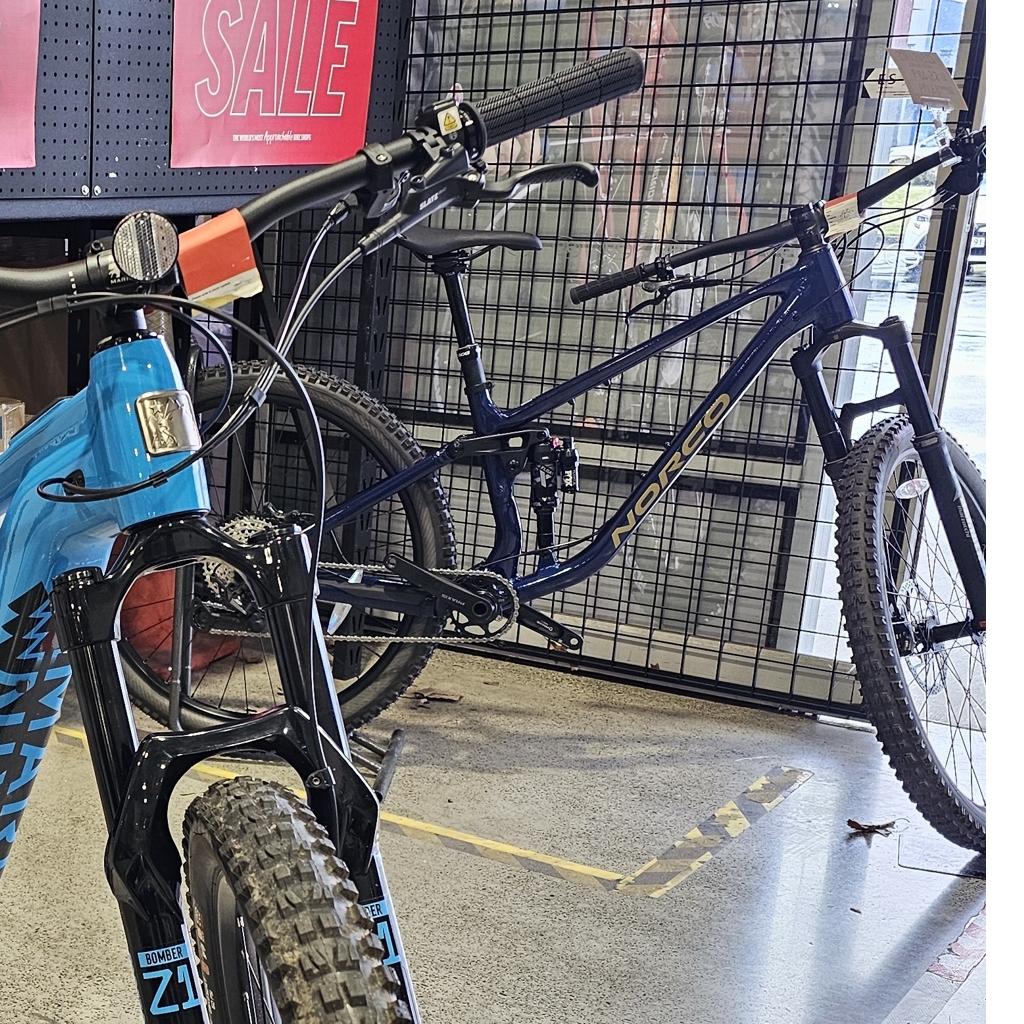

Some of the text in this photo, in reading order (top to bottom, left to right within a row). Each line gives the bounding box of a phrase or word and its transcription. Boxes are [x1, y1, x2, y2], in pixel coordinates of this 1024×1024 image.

[195, 0, 359, 117] SALE
[611, 393, 731, 549] NORCO
[142, 964, 202, 1016] Z1
[144, 946, 184, 965] BOMBER
